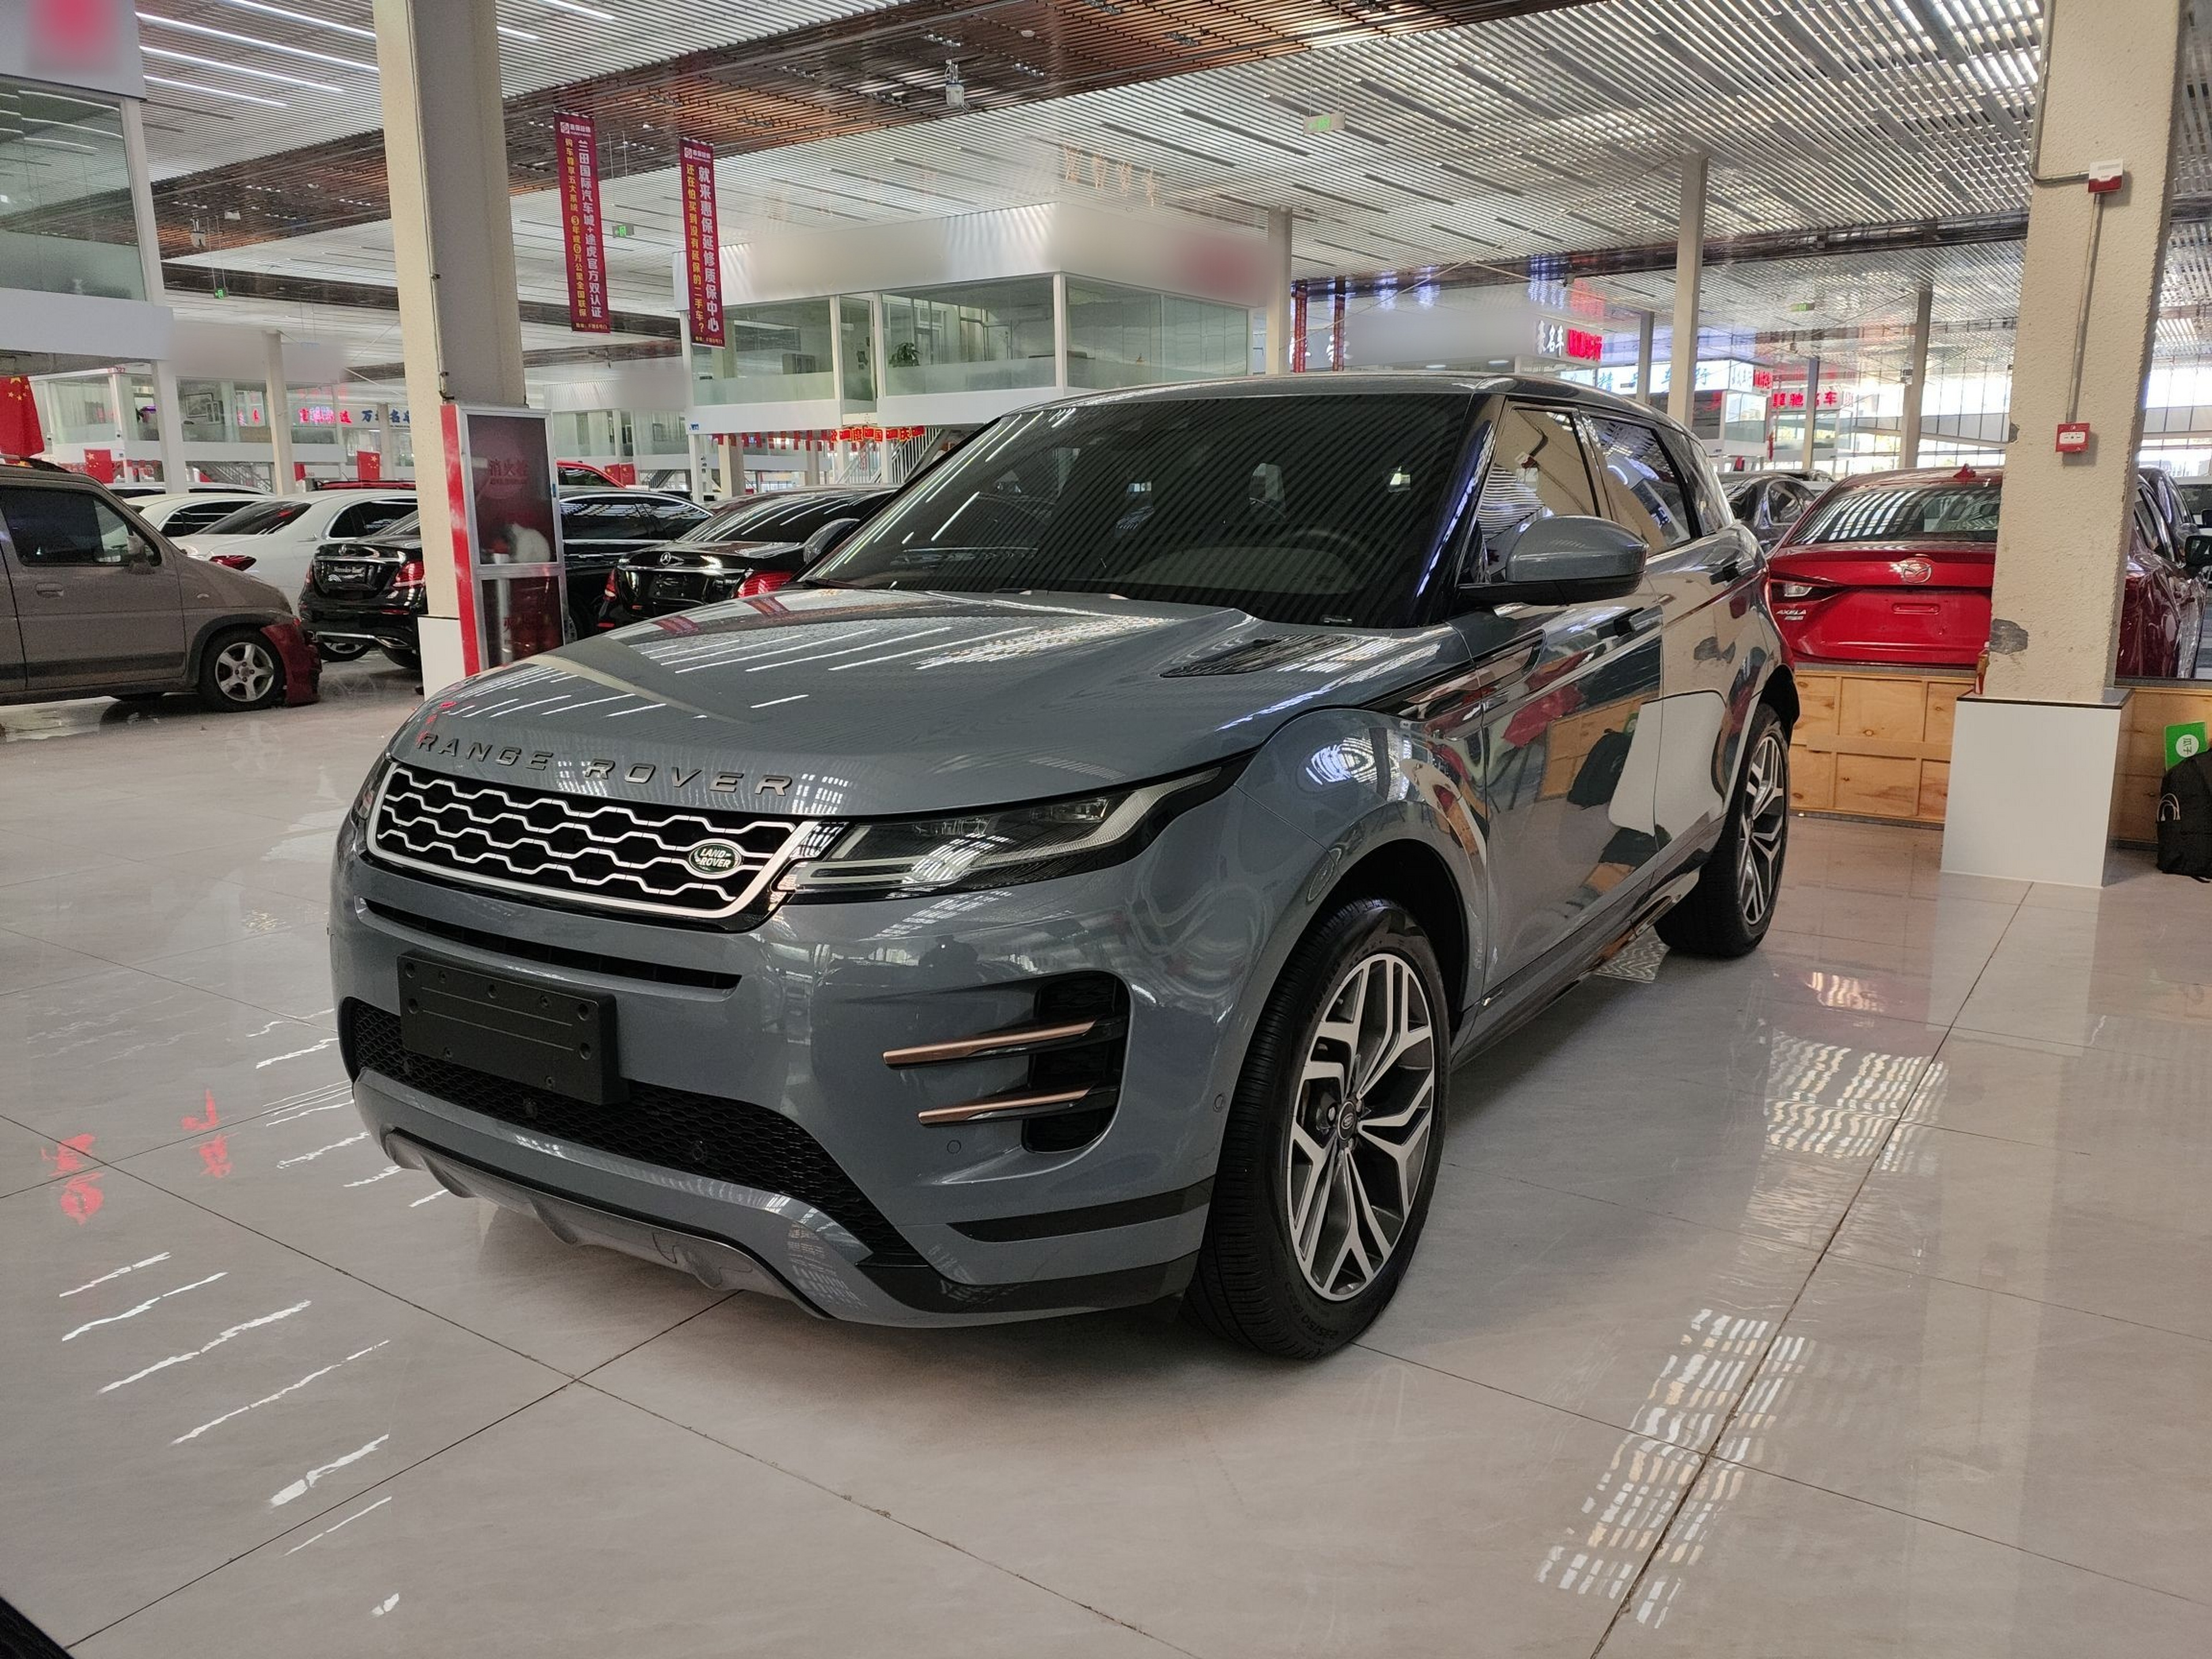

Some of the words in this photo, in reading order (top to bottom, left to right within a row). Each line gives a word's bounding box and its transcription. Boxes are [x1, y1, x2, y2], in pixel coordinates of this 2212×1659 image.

[698, 166, 719, 332] 就来惠保延修质保中心
[416, 730, 554, 771] RANGE
[584, 758, 793, 797] ROVER
